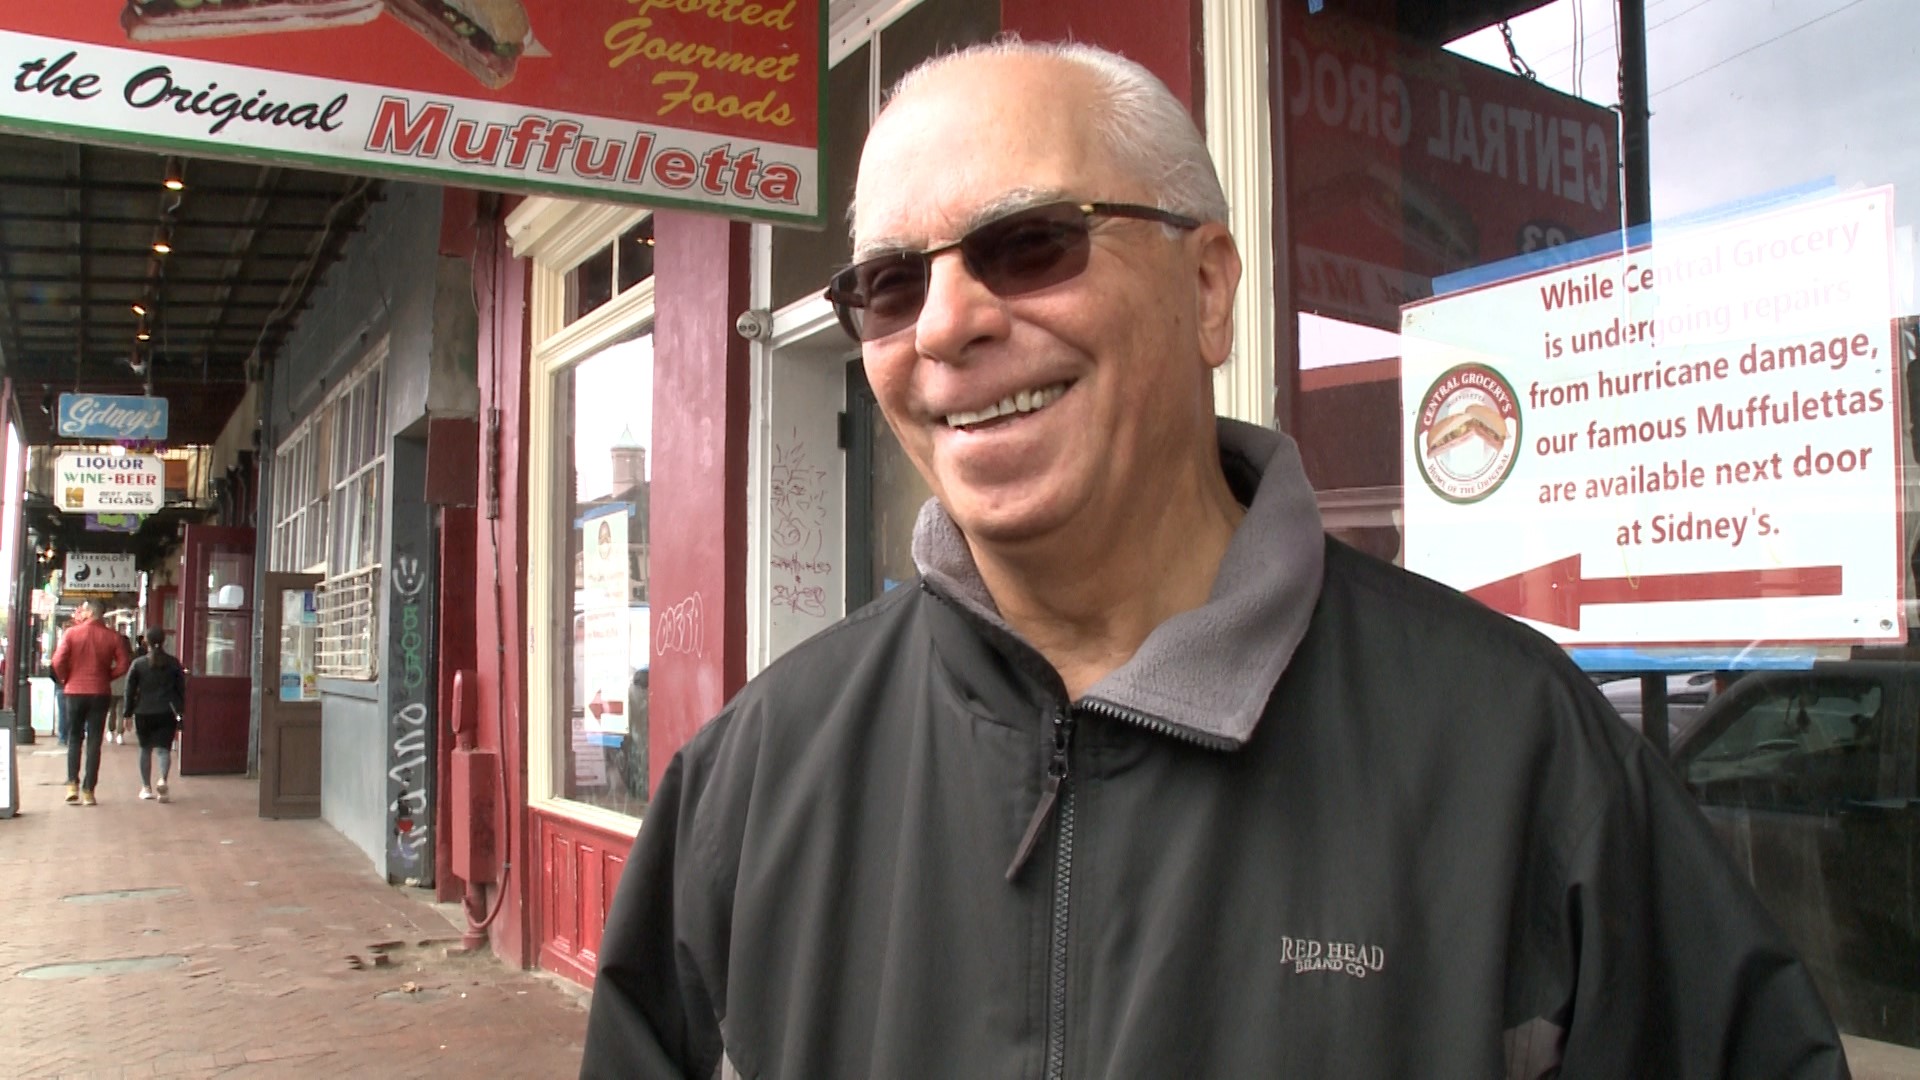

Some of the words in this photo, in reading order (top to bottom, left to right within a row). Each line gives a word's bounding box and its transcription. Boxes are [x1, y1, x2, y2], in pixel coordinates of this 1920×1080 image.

[627, 0, 797, 31] ported
[603, 16, 800, 83] Gourmet
[651, 70, 796, 127] Foods
[13, 50, 102, 100] the
[123, 64, 349, 135] Original
[364, 95, 802, 205] Muffuletta
[1540, 271, 1614, 312] While
[1733, 221, 1861, 268] Grocery
[1544, 332, 1564, 360] is
[1571, 302, 1732, 355] undergoing
[1422, 375, 1460, 427] CENTRAL
[1461, 373, 1513, 413] GROCERY'S
[1529, 379, 1590, 410] from
[1598, 356, 1729, 399] hurricane
[1739, 333, 1879, 376] damage,
[1536, 431, 1578, 456] our
[1586, 415, 1687, 449] famous
[1697, 387, 1884, 435] Muffulettas
[76, 457, 144, 470] LIQUOR
[1538, 480, 1577, 504] are
[1585, 459, 1706, 500] available
[1715, 452, 1783, 485] next
[1792, 444, 1873, 478] door
[1616, 519, 1642, 547] at
[1650, 507, 1781, 547] Sidney's.
[1280, 935, 1322, 964] RED
[1327, 941, 1385, 972] HEAD
[1295, 957, 1344, 974] BRAND
[1345, 962, 1366, 979] CO
